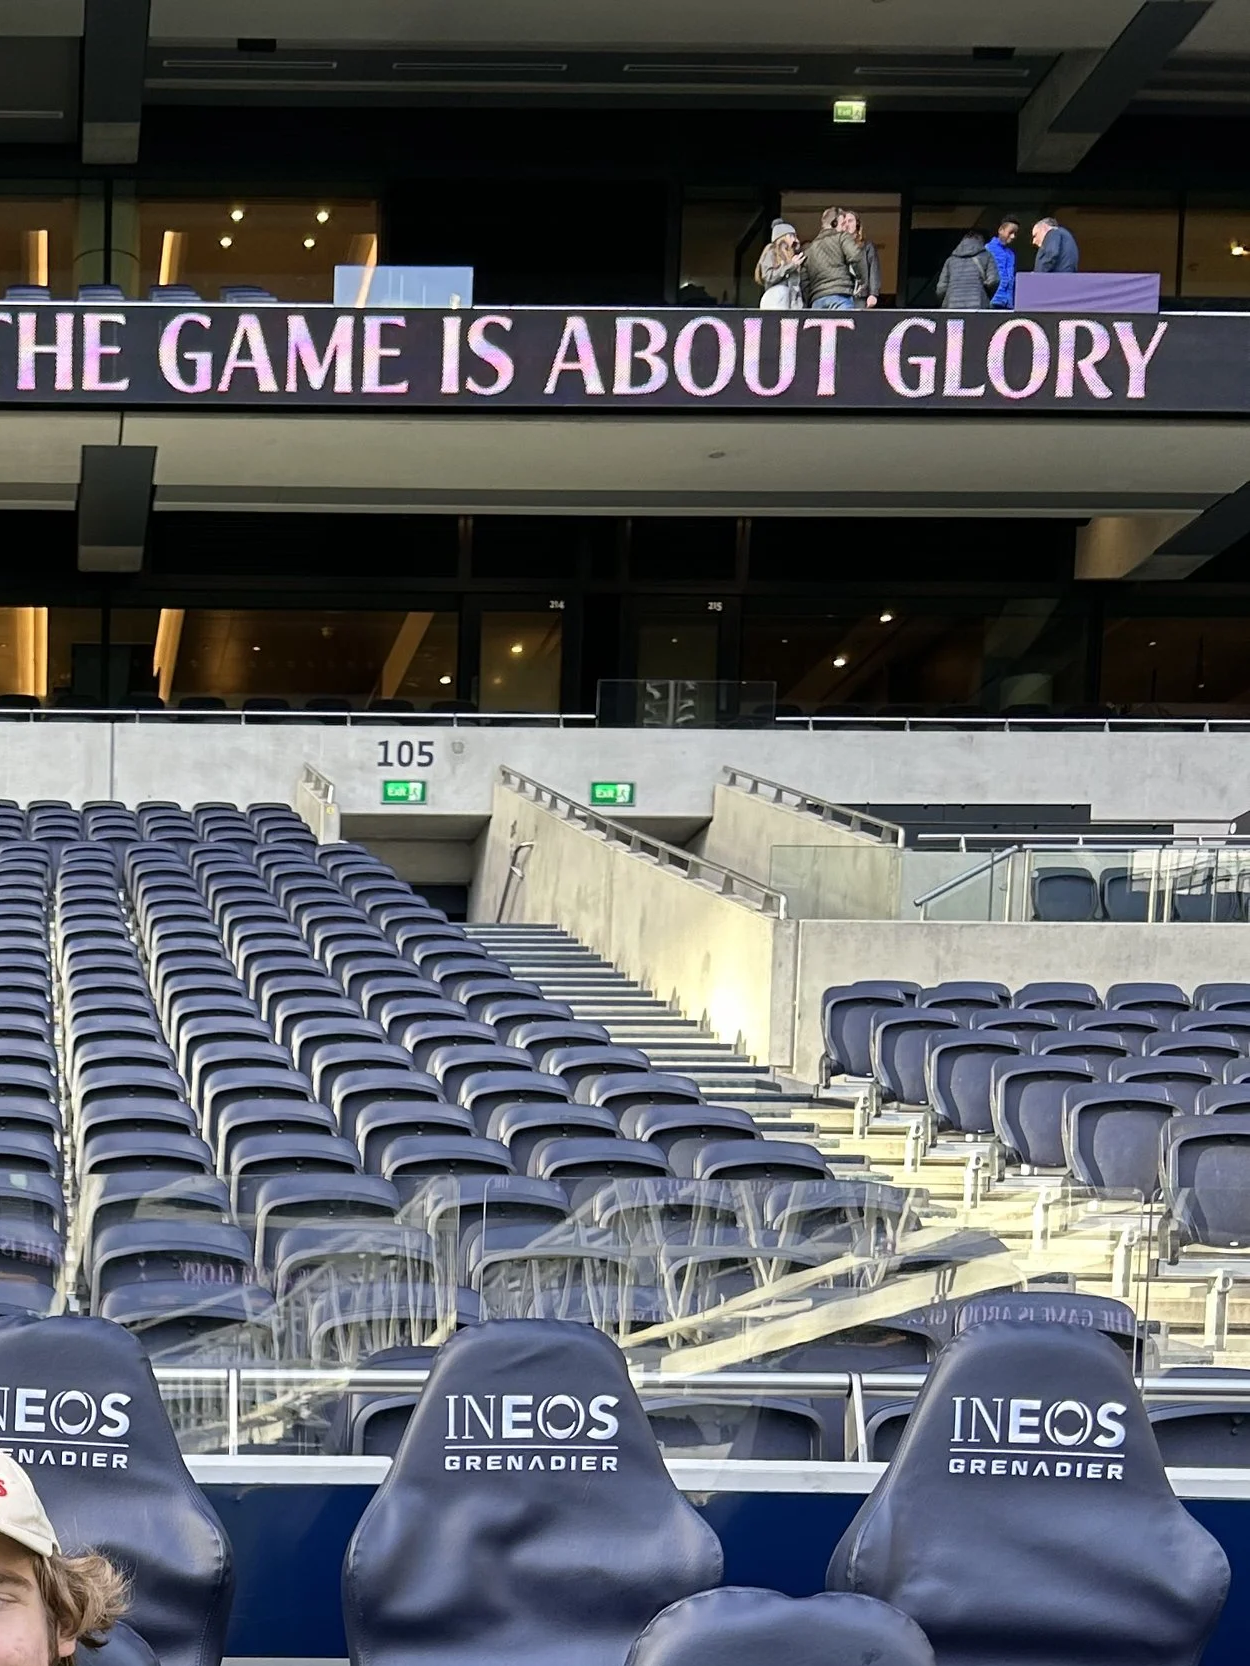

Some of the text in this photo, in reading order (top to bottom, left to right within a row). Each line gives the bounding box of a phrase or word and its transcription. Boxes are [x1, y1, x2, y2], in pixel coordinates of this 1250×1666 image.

[158, 313, 409, 394] GAME
[440, 315, 515, 396] IS
[544, 316, 855, 397] ABOUT
[882, 317, 1169, 400] GLORY
[377, 740, 434, 768] 105
[445, 1393, 620, 1441] INEOS
[949, 1396, 1127, 1448] INEOS
[0, 1447, 129, 1470] ENADIER
[444, 1455, 619, 1473] GRENADIER
[948, 1458, 1125, 1481] GRENADIER
